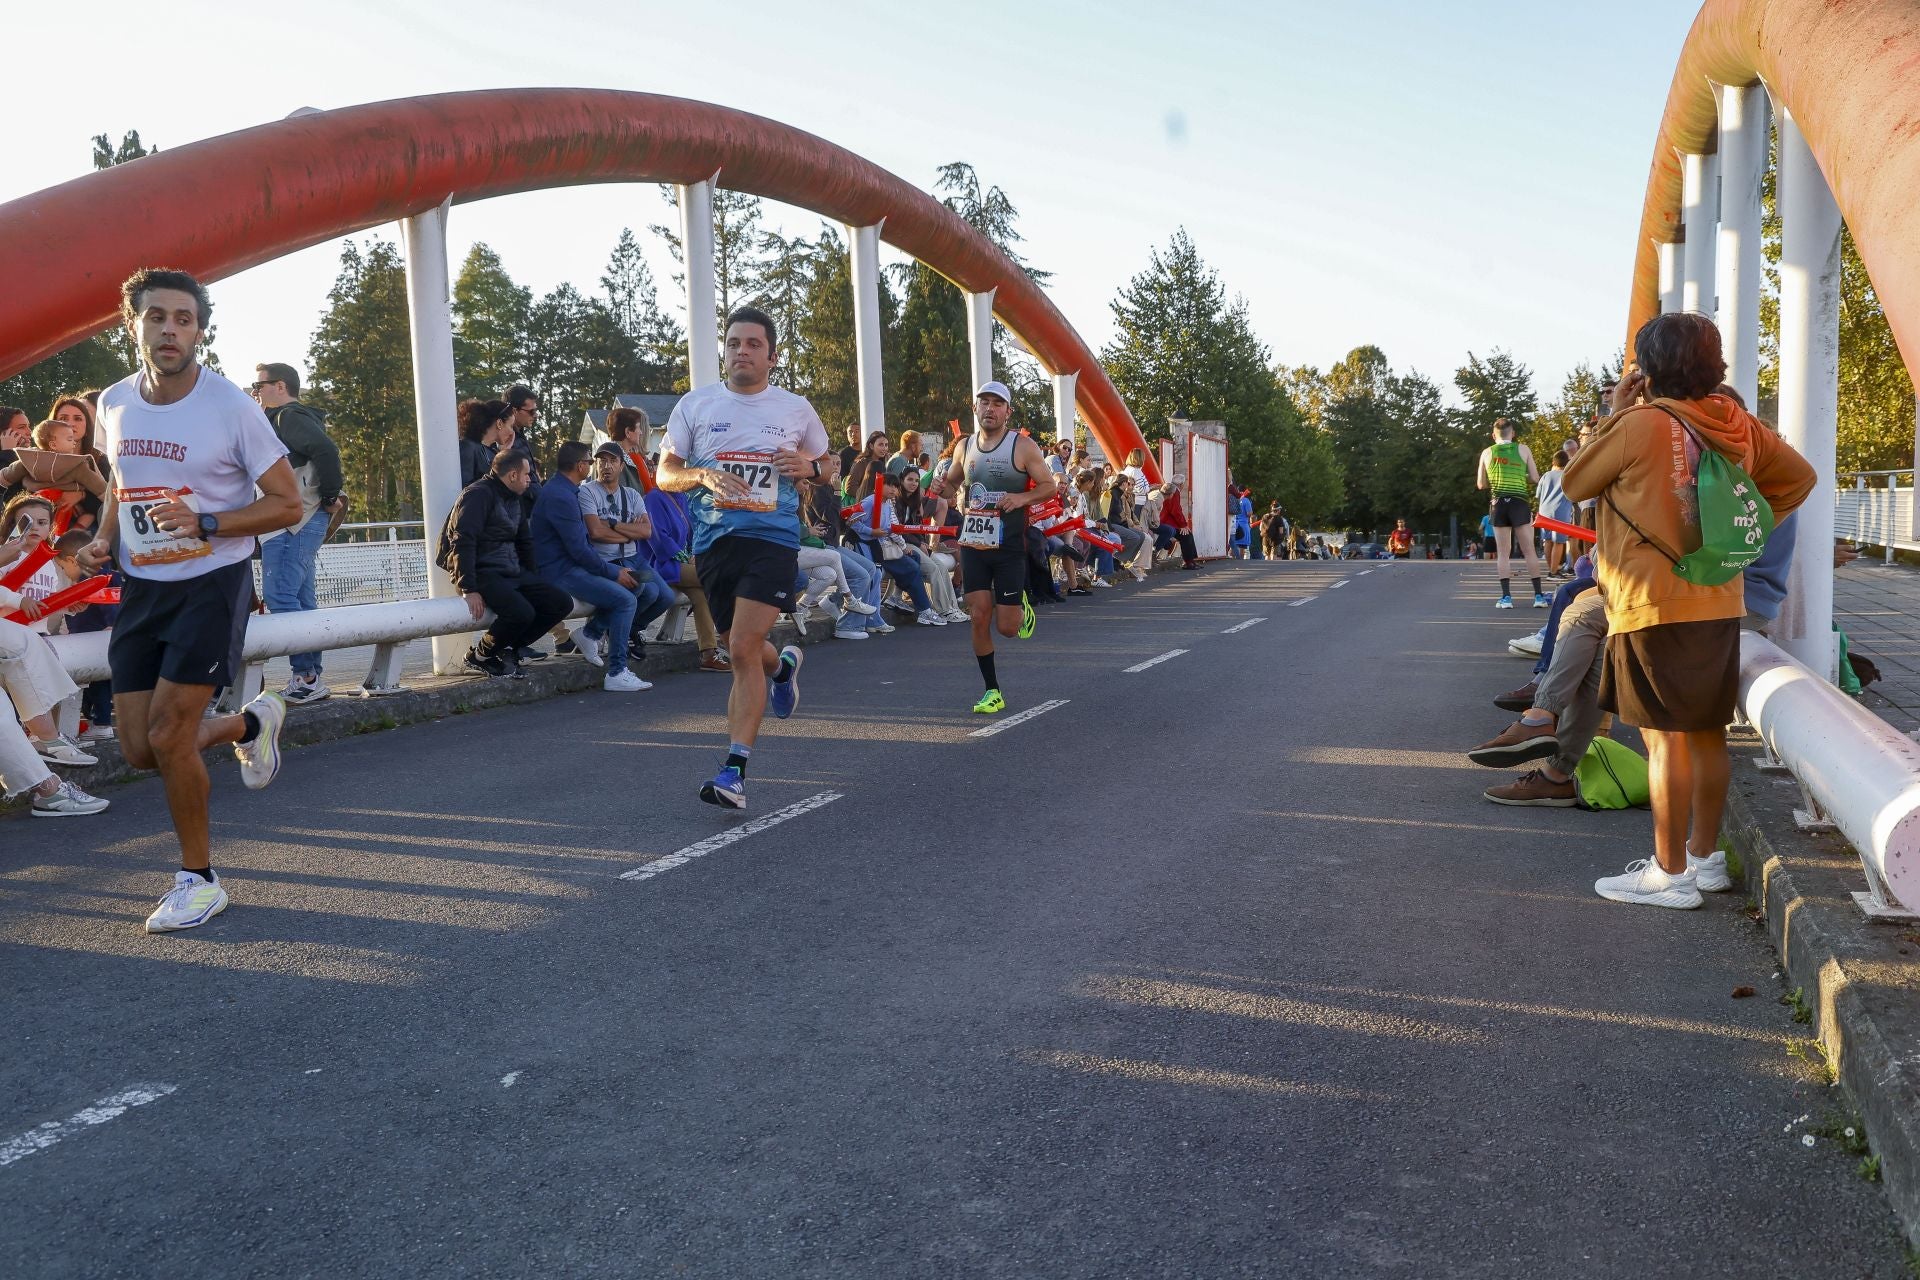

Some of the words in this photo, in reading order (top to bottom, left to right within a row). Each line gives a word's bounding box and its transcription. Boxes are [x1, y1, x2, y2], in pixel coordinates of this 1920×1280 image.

[117, 439, 187, 463] CRUSADERS
[1671, 440, 1682, 452] OF
[1673, 455, 1685, 471] OUT
[965, 517, 995, 535] 264
